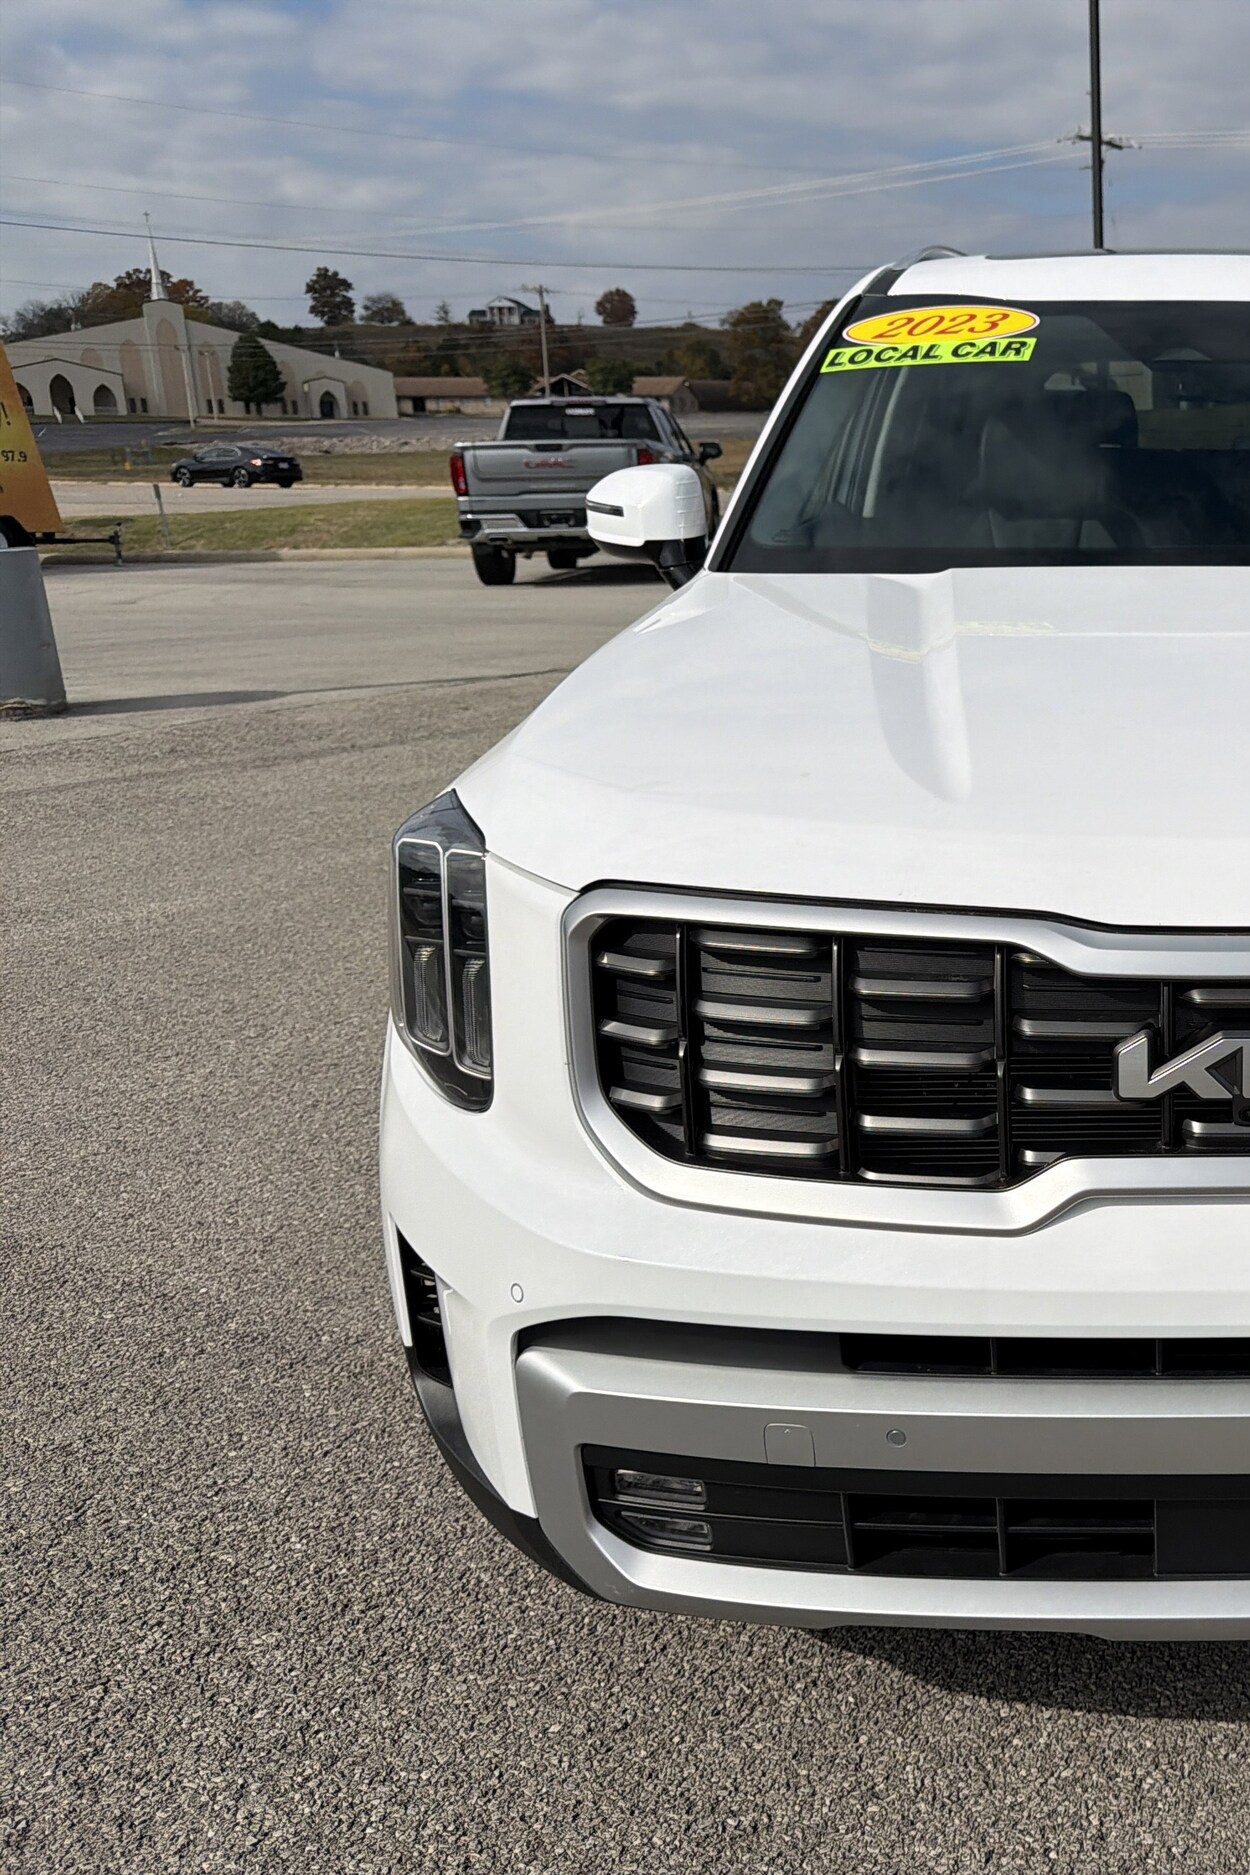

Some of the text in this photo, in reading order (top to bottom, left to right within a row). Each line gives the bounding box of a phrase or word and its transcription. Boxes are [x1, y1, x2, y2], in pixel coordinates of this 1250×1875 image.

[872, 313, 1010, 339] 2023
[826, 340, 1029, 368] LOCAL CAR
